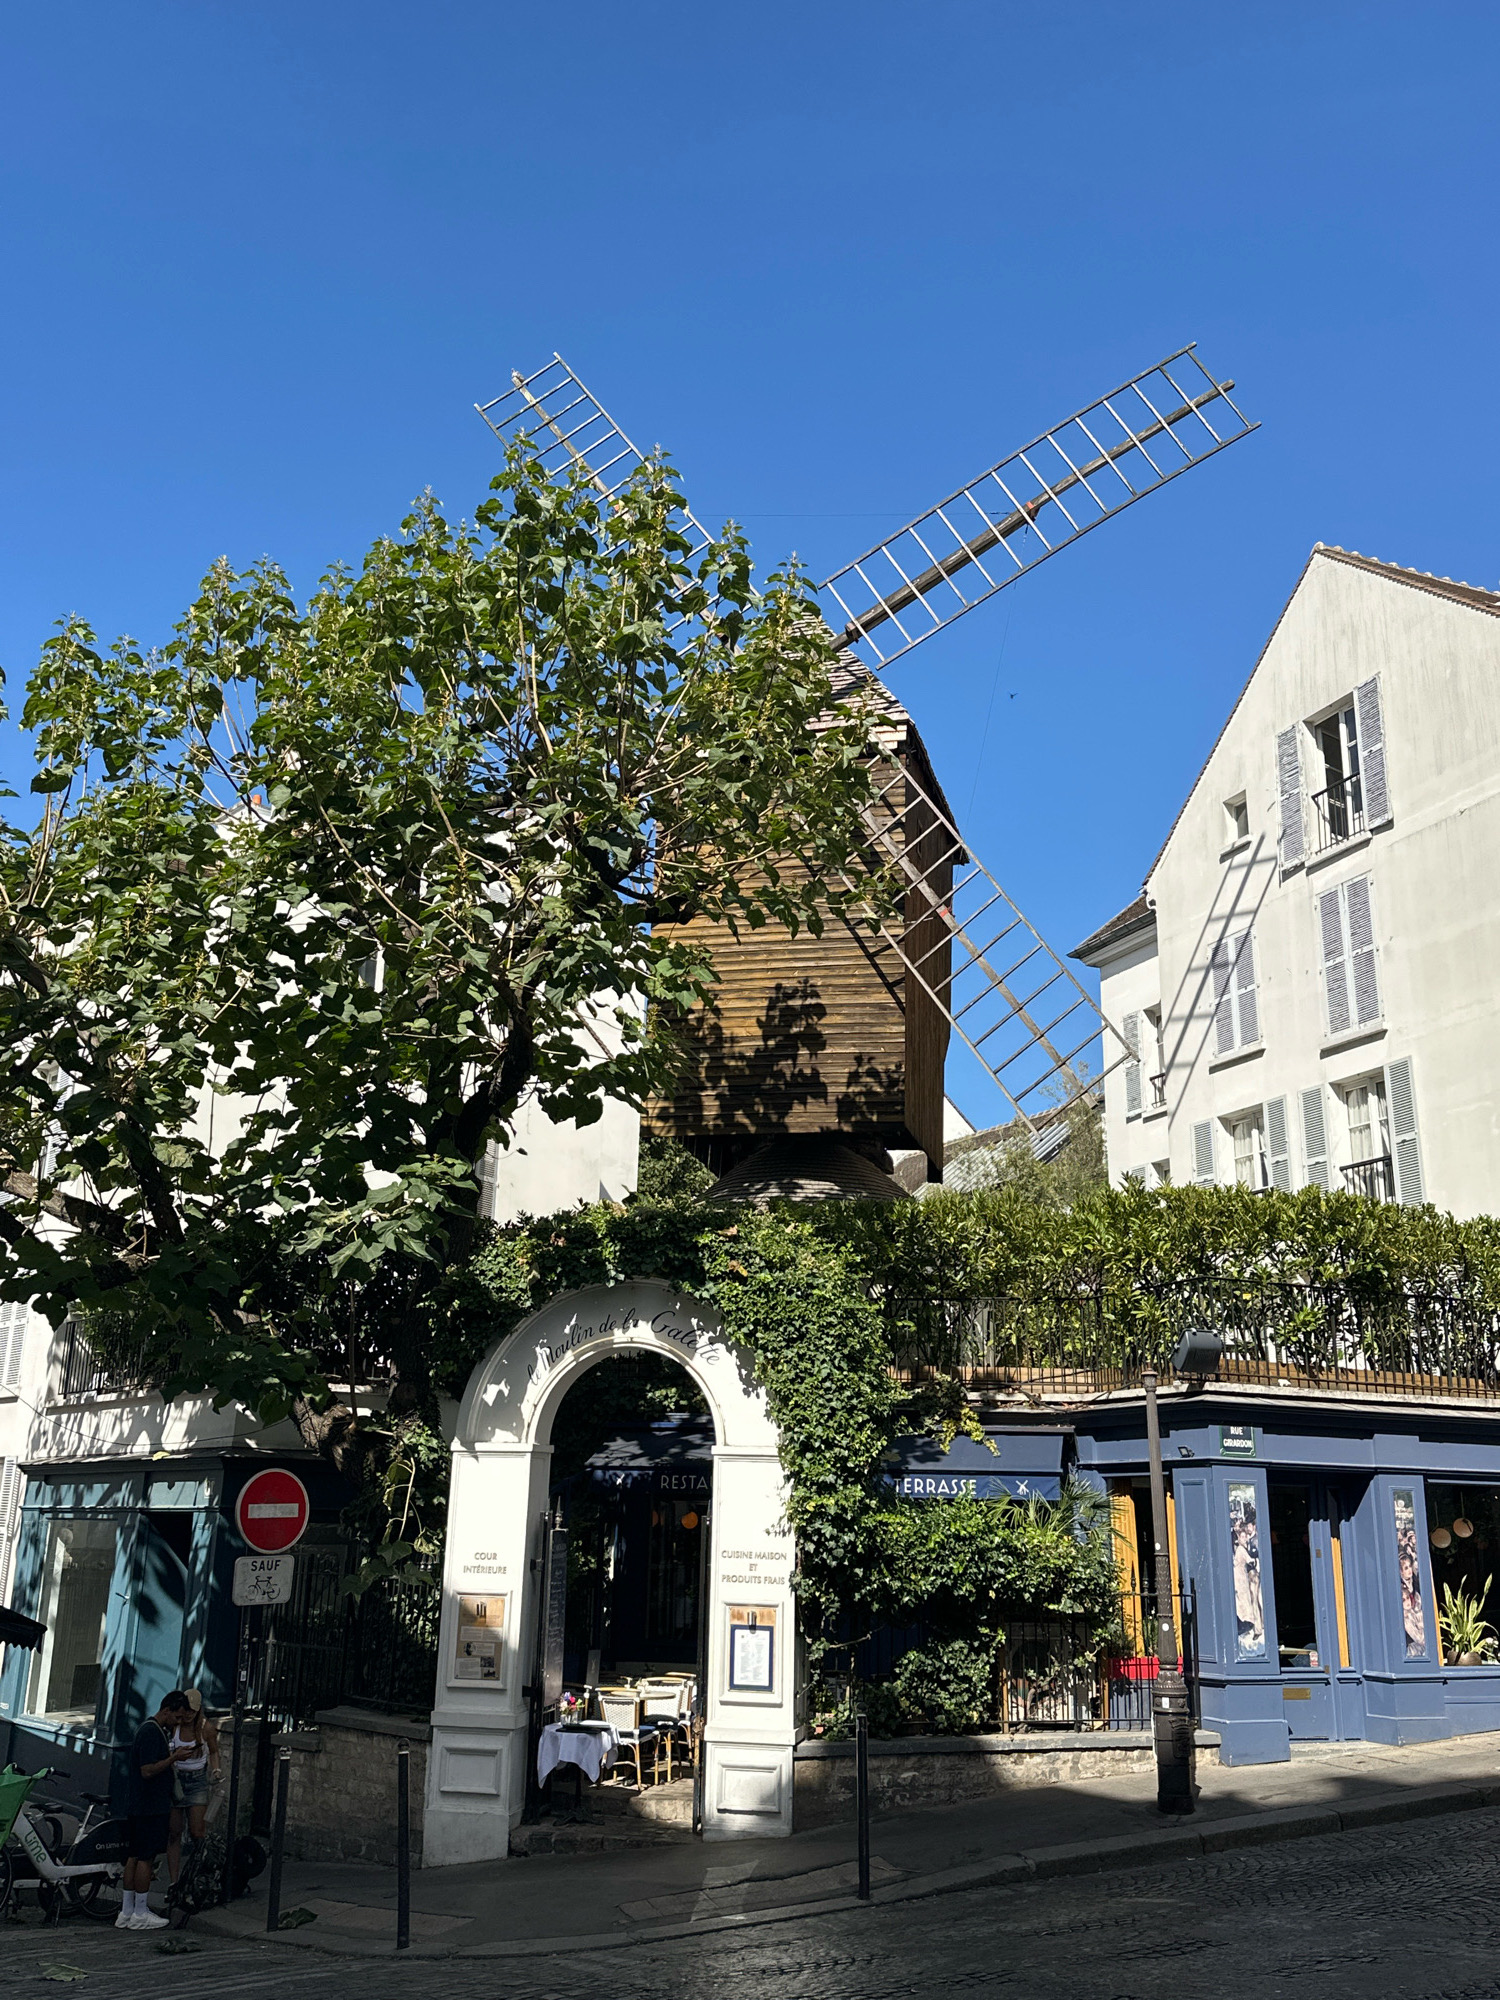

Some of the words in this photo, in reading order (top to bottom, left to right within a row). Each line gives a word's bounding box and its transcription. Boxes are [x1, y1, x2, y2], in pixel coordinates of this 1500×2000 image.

[538, 1322, 595, 1371] Moulin
[599, 1314, 618, 1334] de
[622, 1307, 640, 1330] la
[651, 1310, 720, 1366] Galette
[1230, 1426, 1244, 1435] RUE
[1223, 1438, 1253, 1448] GIRARDON
[661, 1475, 713, 1489] RESTA
[893, 1478, 977, 1495] TERRASSE
[474, 1552, 498, 1561] COUR
[721, 1550, 753, 1560] CUISINE
[754, 1551, 787, 1560] MAISON
[251, 1560, 281, 1571] SAUF
[463, 1564, 507, 1575] INTÉRIEURE
[748, 1563, 758, 1572] ET
[721, 1574, 762, 1585] PRODUITS
[763, 1576, 785, 1585] FRAIS
[24, 1830, 47, 1863] Lime
